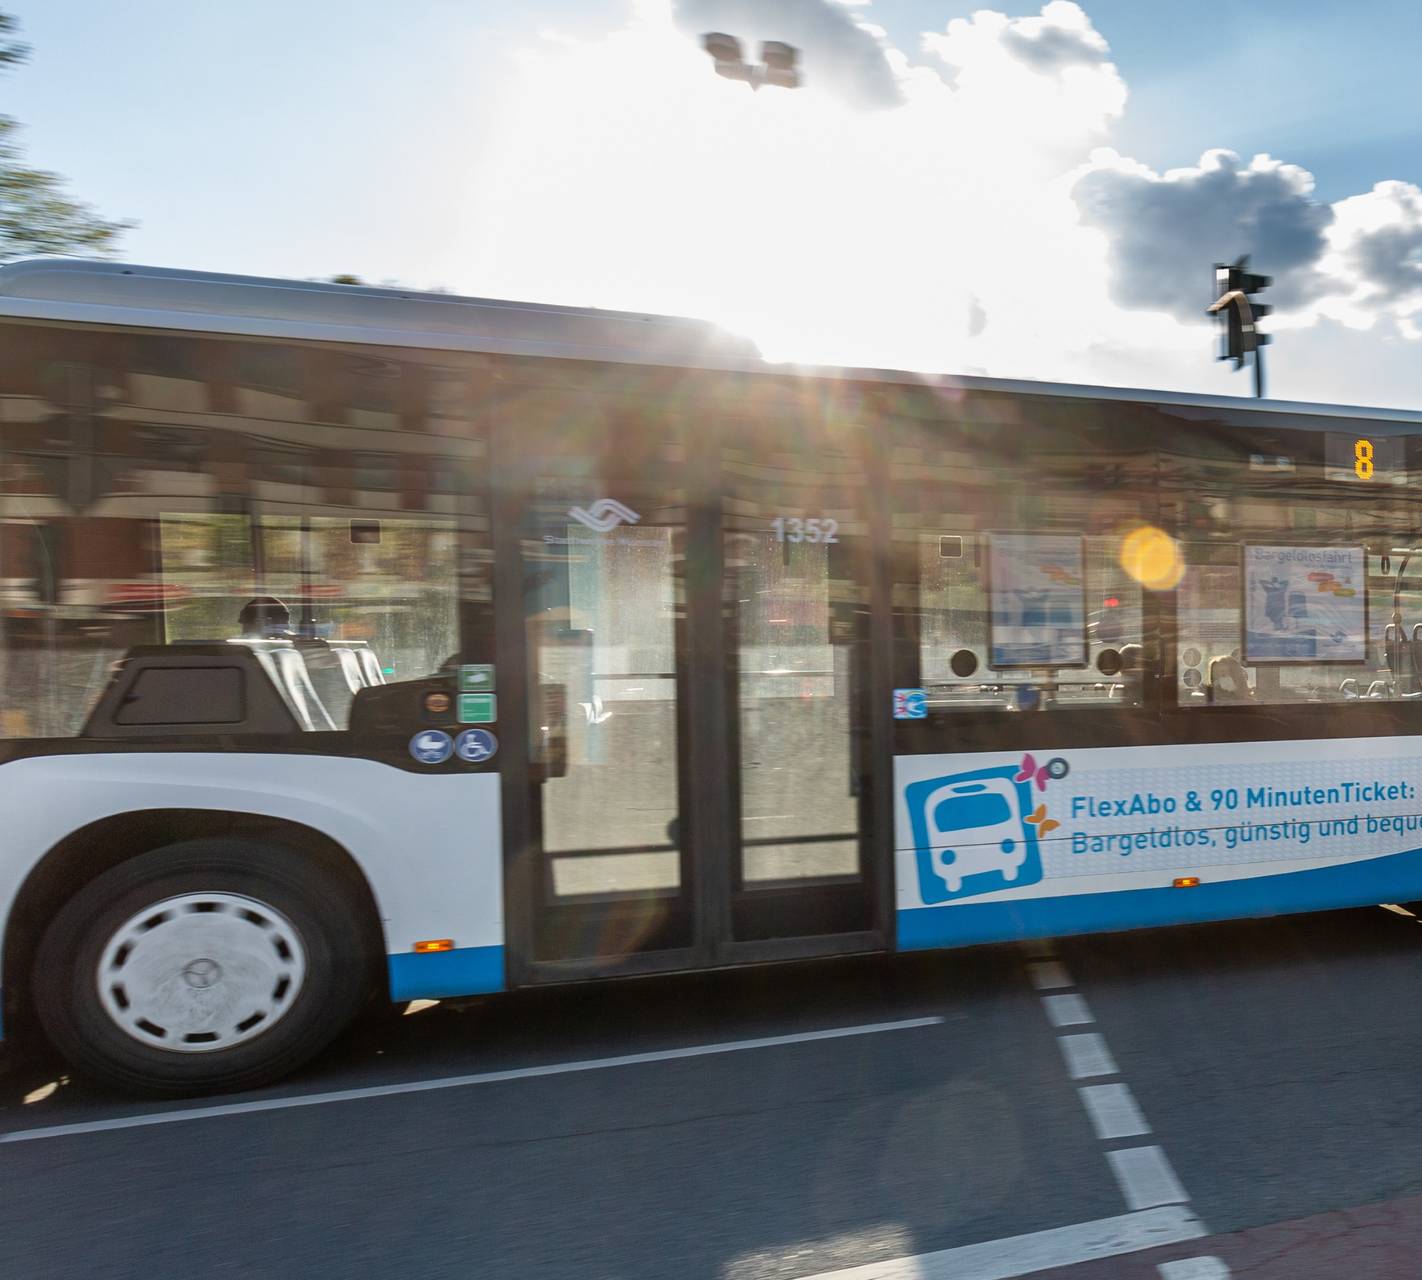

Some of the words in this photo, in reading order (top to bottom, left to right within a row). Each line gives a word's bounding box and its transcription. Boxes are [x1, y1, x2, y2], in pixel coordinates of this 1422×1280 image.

[1354, 439, 1374, 480] 8
[770, 517, 839, 544] 1352
[1071, 793, 1177, 819] FlexAbo
[1184, 790, 1202, 812] &
[1210, 788, 1239, 811] 90
[1247, 781, 1415, 808] MinutenTicket:
[1072, 826, 1217, 856] Bargeldlos,
[1225, 819, 1310, 849] günstig
[1319, 815, 1359, 837] und
